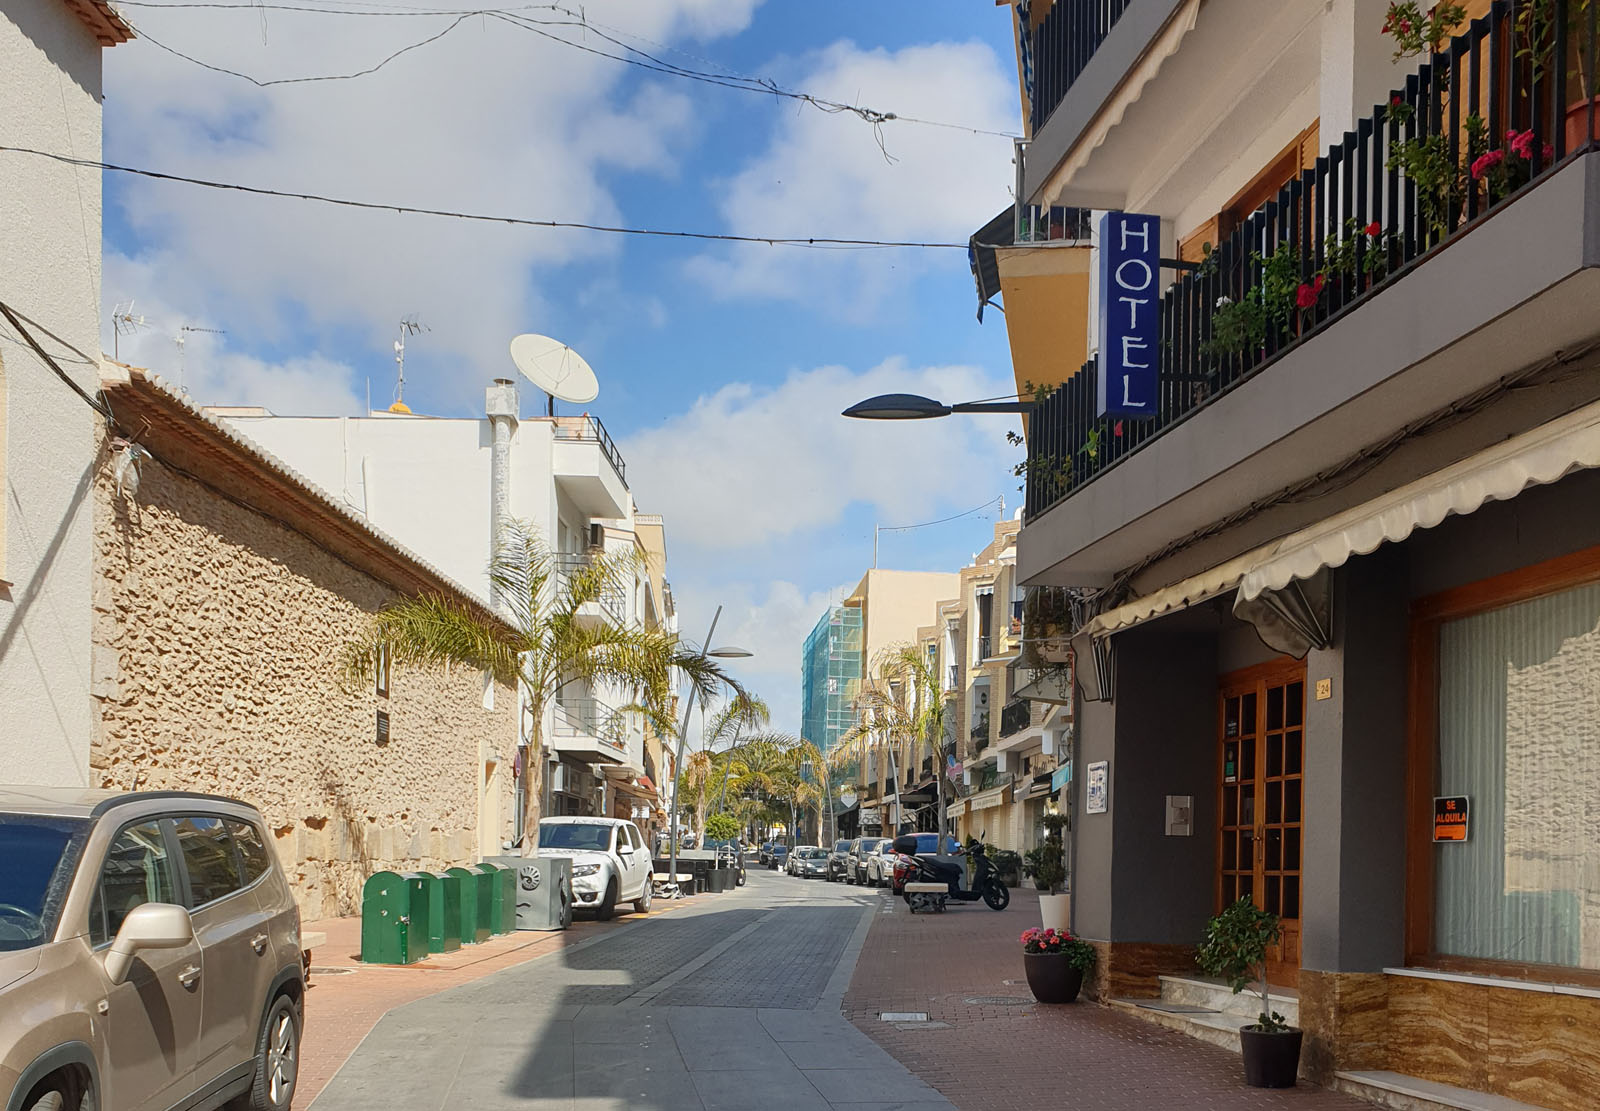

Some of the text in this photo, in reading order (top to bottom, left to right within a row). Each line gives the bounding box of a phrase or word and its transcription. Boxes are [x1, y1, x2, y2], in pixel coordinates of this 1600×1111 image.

[1115, 219, 1152, 407] HOTEL
[1446, 800, 1456, 810] SE
[1436, 812, 1466, 823] ALQUILA
